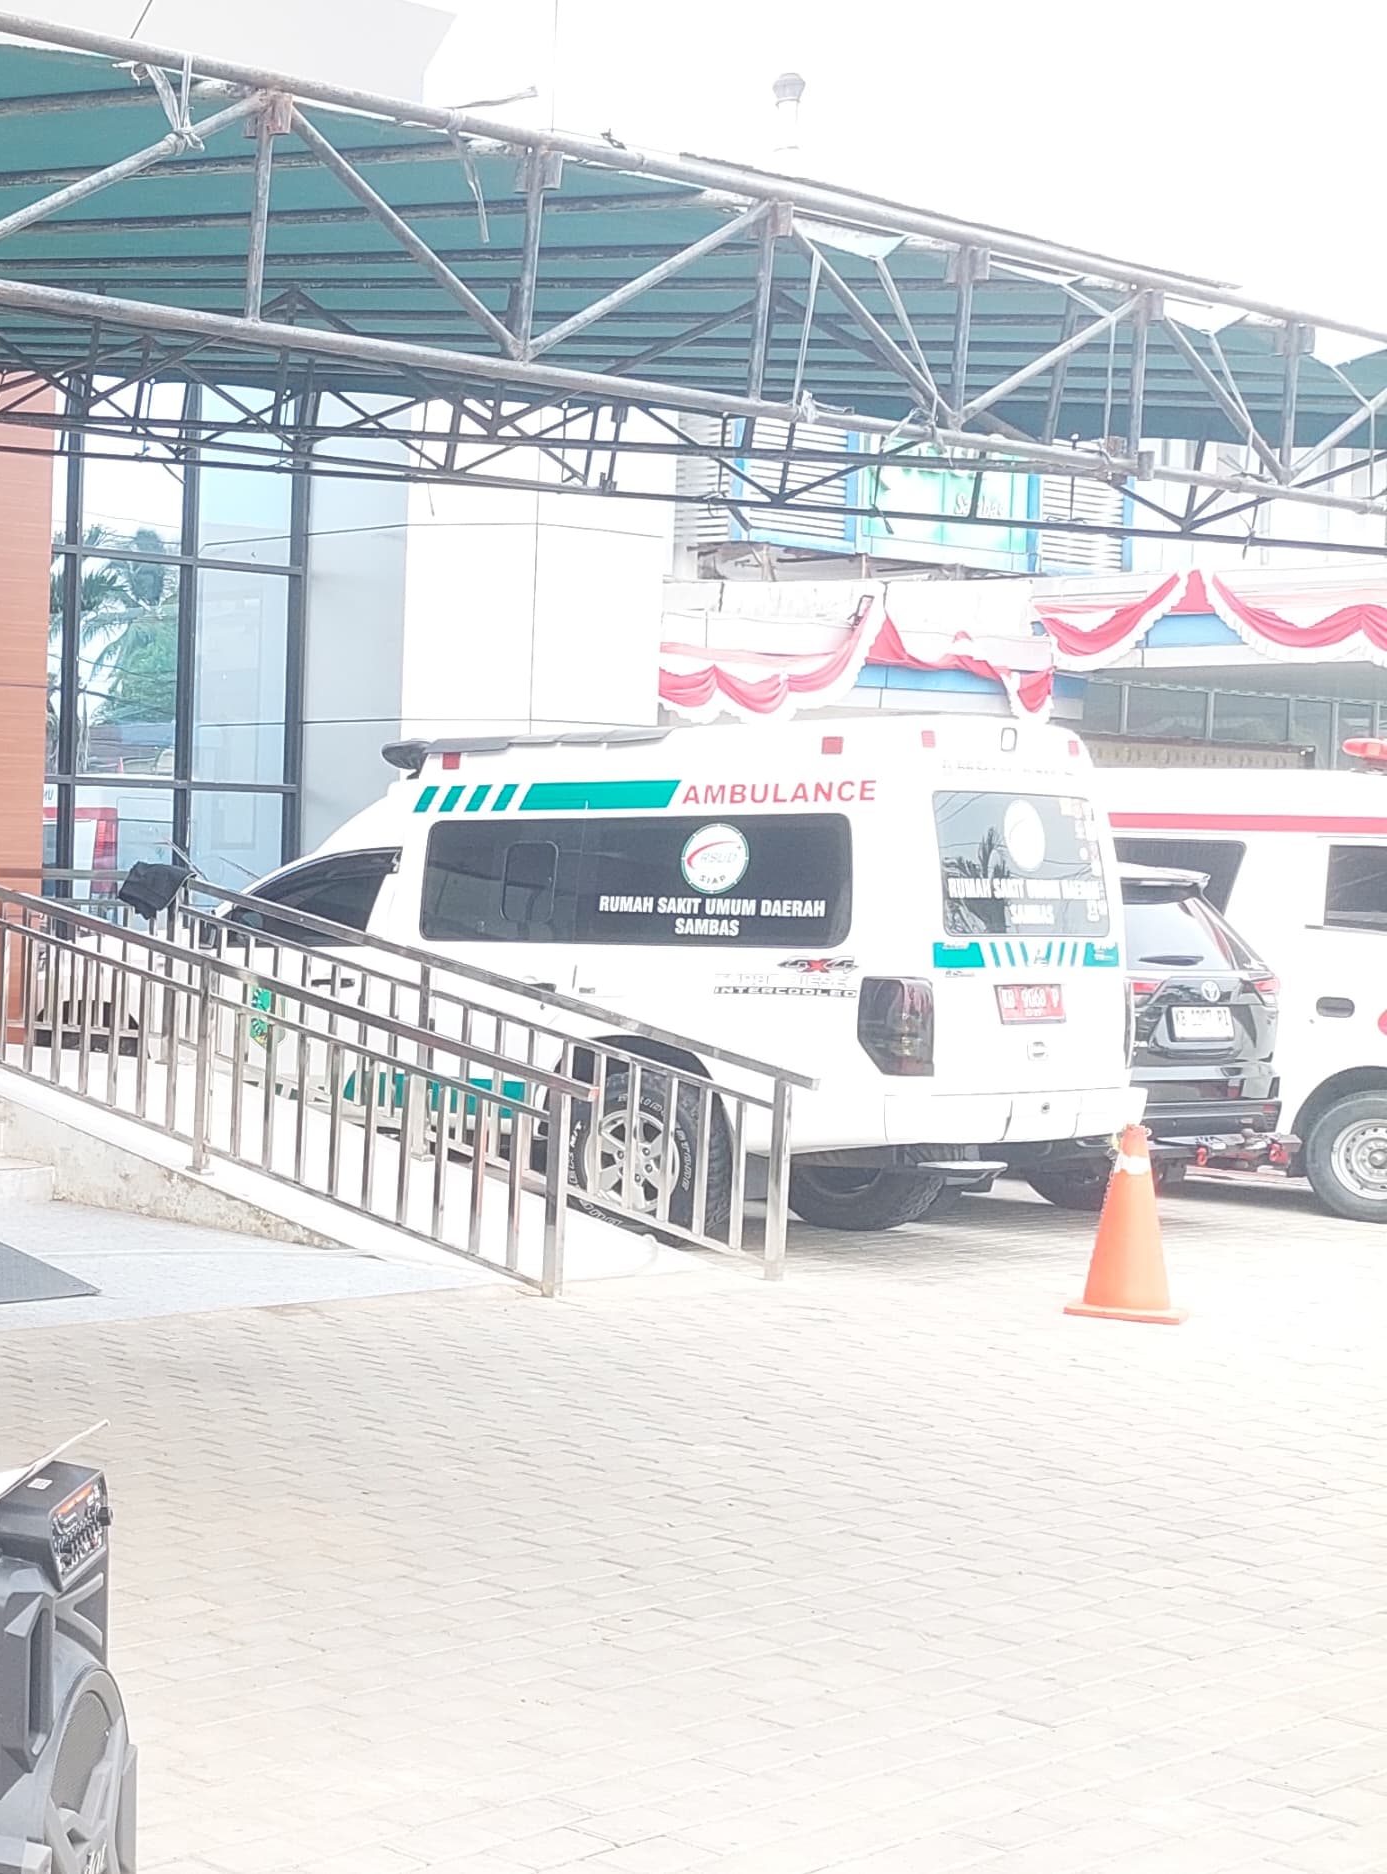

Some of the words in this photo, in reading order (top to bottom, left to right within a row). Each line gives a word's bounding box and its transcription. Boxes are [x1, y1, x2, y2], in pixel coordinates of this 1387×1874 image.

[682, 780, 877, 805] AMBULANCE
[599, 896, 654, 914] RUMAH
[657, 897, 701, 915] SAKIT
[705, 898, 756, 917] UMUM
[760, 899, 826, 918] DAERAH
[674, 918, 740, 937] SAMBAS
